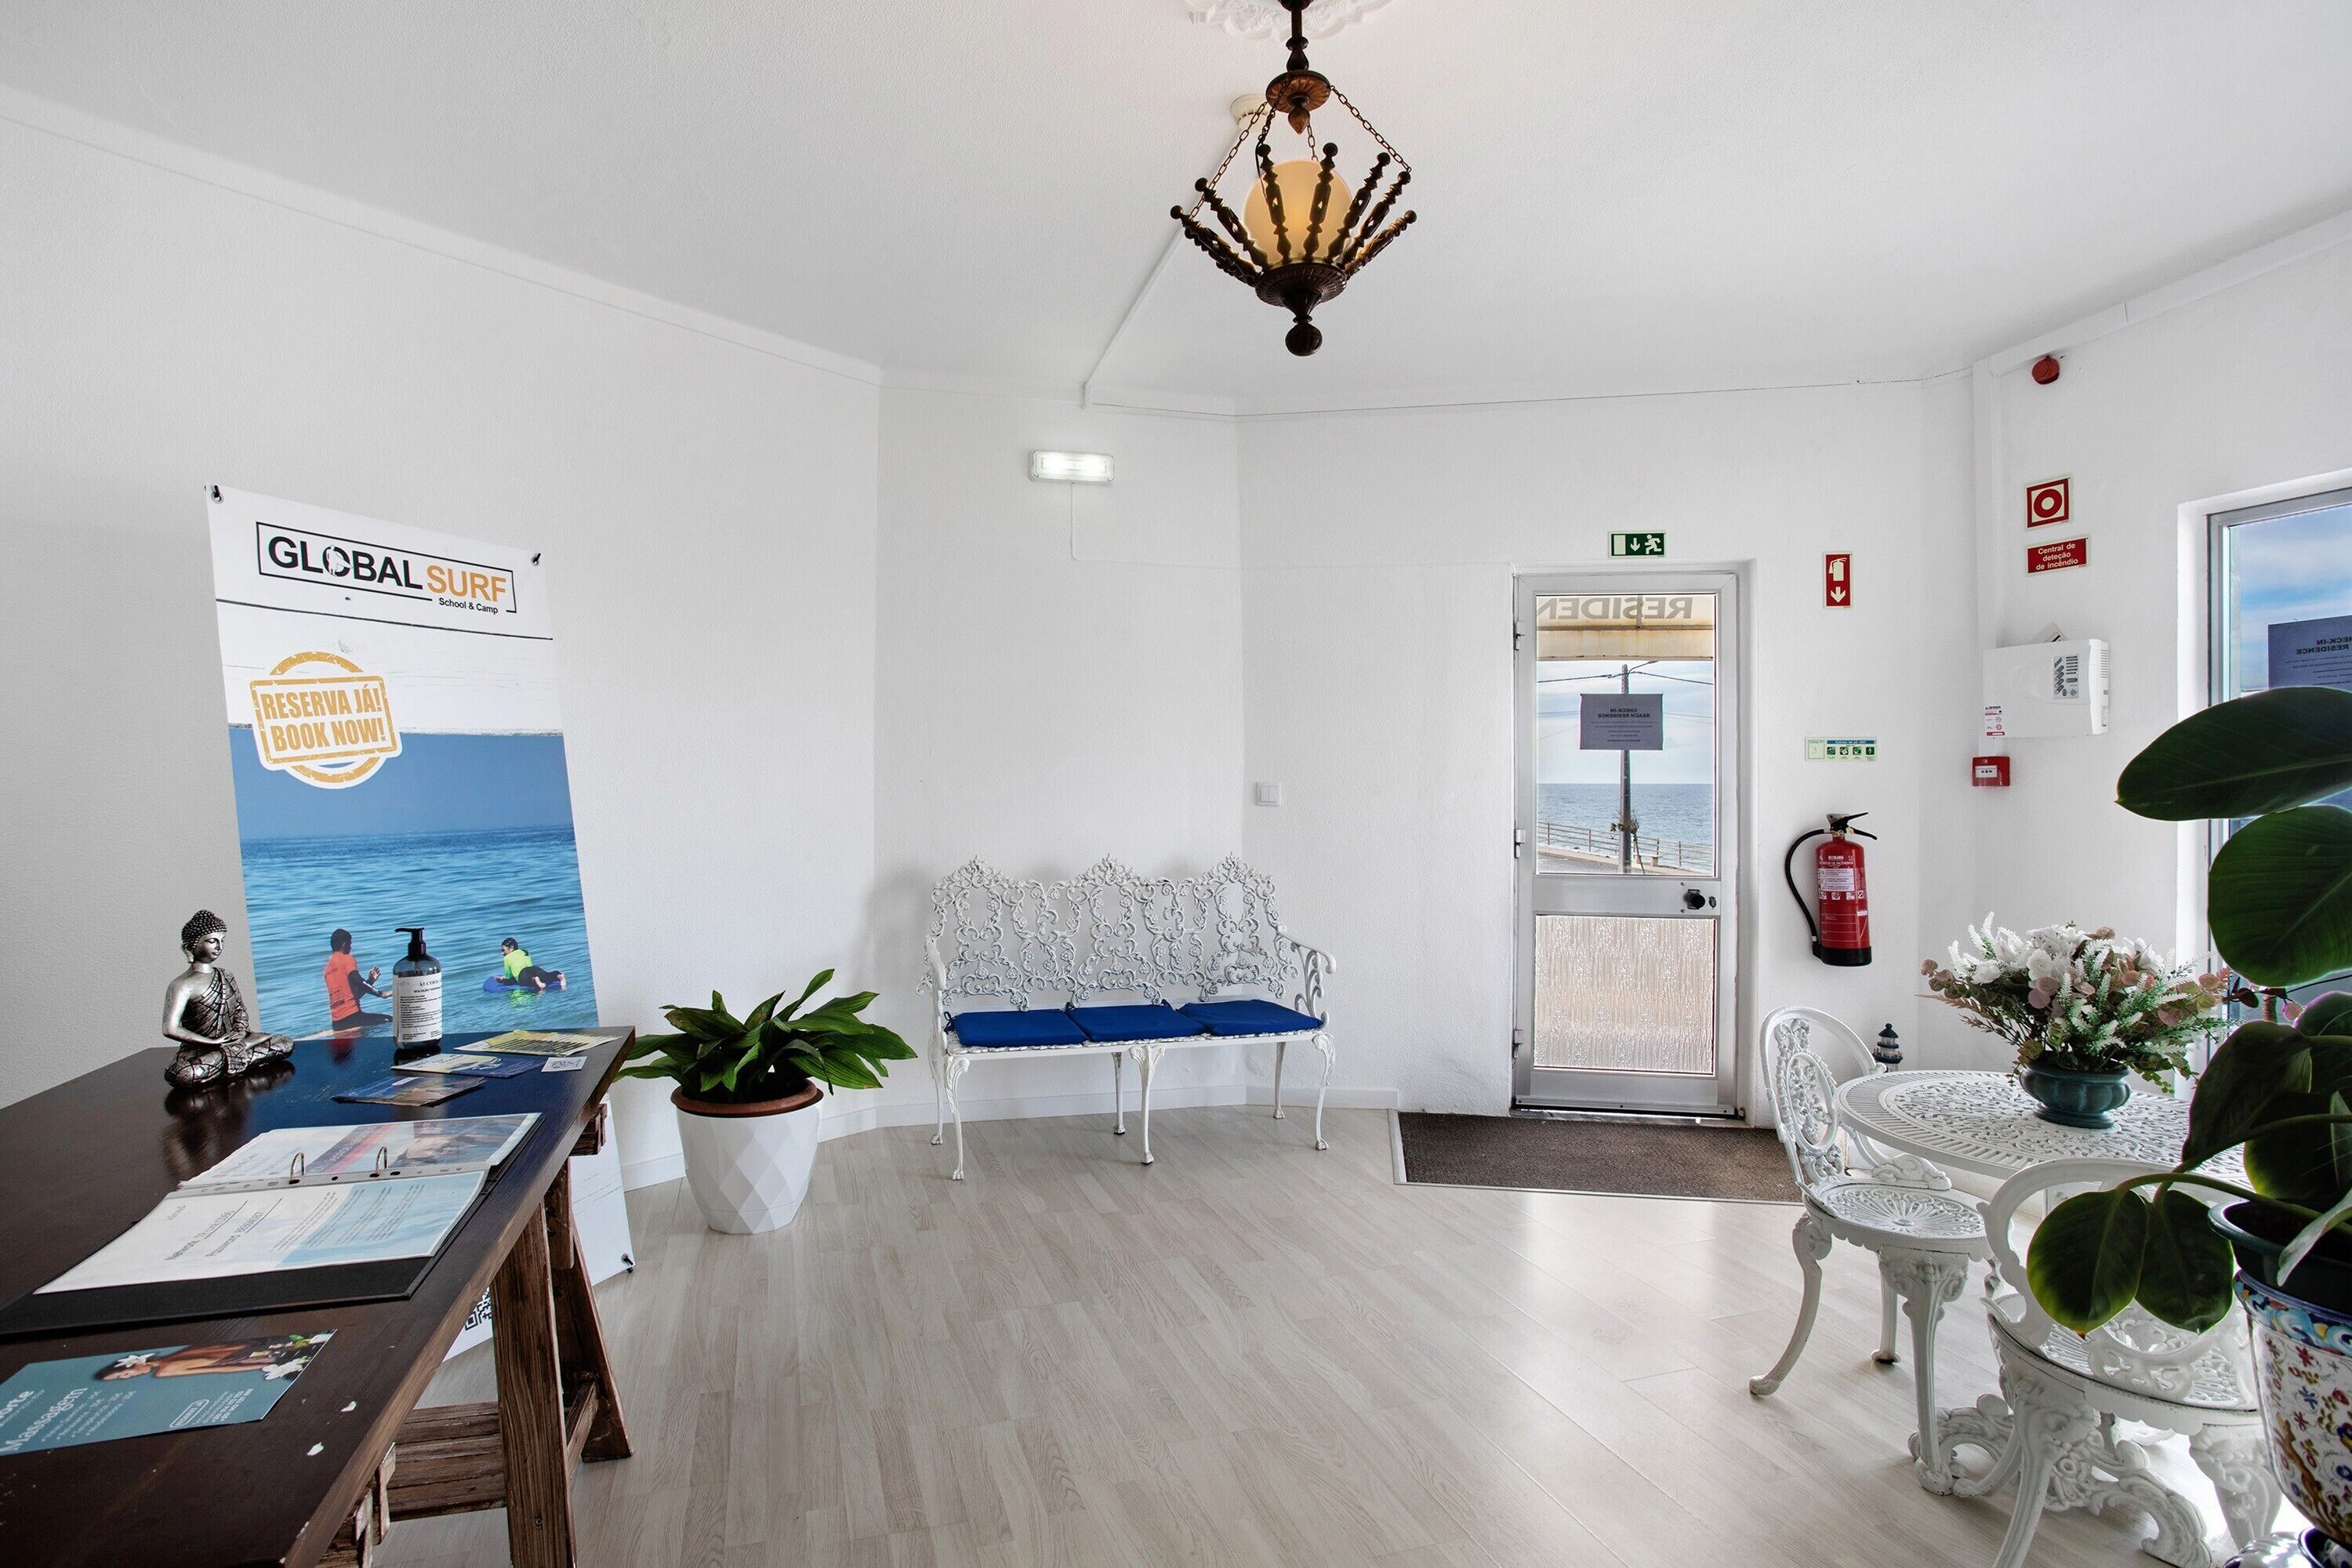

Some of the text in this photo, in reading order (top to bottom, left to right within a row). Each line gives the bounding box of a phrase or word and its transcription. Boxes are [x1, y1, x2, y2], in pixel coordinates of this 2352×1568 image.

[2038, 544, 2063, 555] Central
[2042, 551, 2071, 562] deteção
[268, 535, 507, 602] GLOBAL SURF
[2047, 557, 2079, 568] incêndio
[438, 597, 499, 615] School & Camp
[261, 684, 383, 720] RESERVA JÁ!
[270, 717, 387, 753] BOOK NOW!
